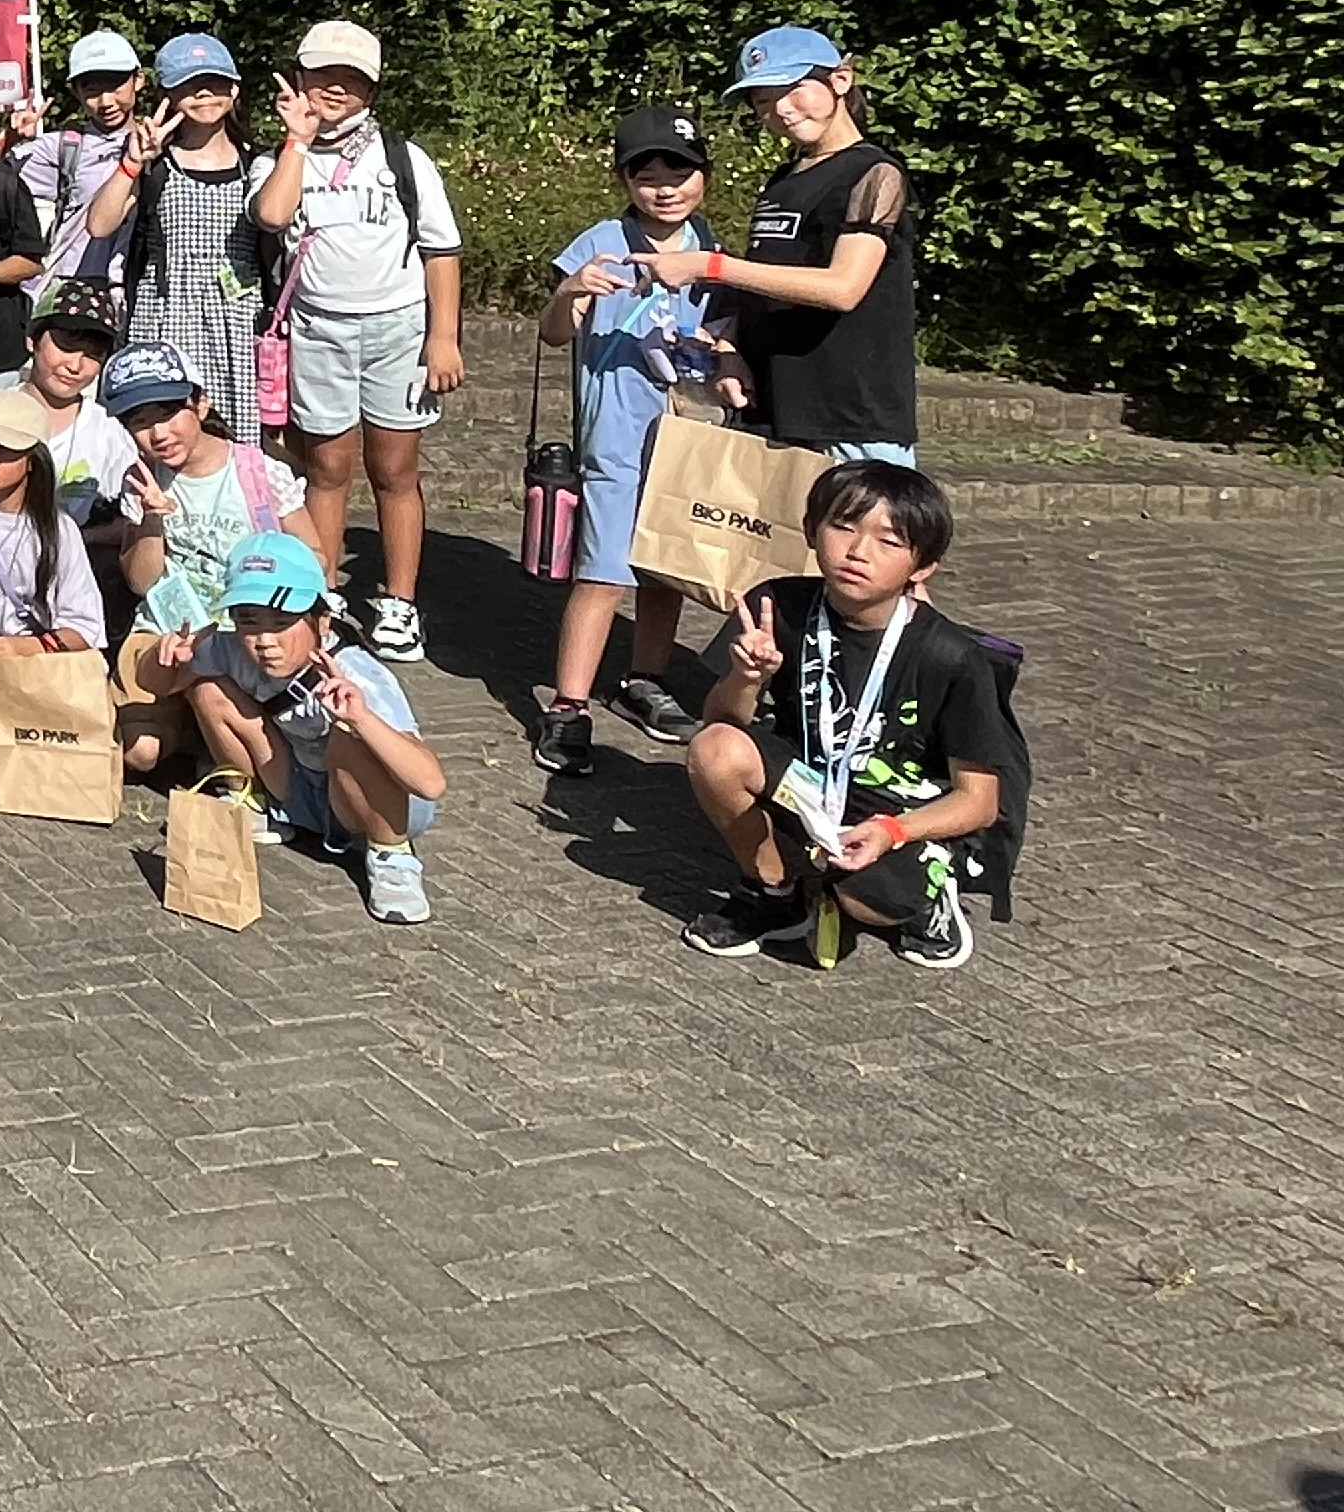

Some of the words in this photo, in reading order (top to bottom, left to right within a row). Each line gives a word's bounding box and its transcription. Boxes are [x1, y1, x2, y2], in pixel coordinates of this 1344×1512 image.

[692, 502, 725, 522] BIO
[728, 512, 772, 539] PARK
[14, 727, 39, 741] BIO
[42, 729, 80, 745] PARK
